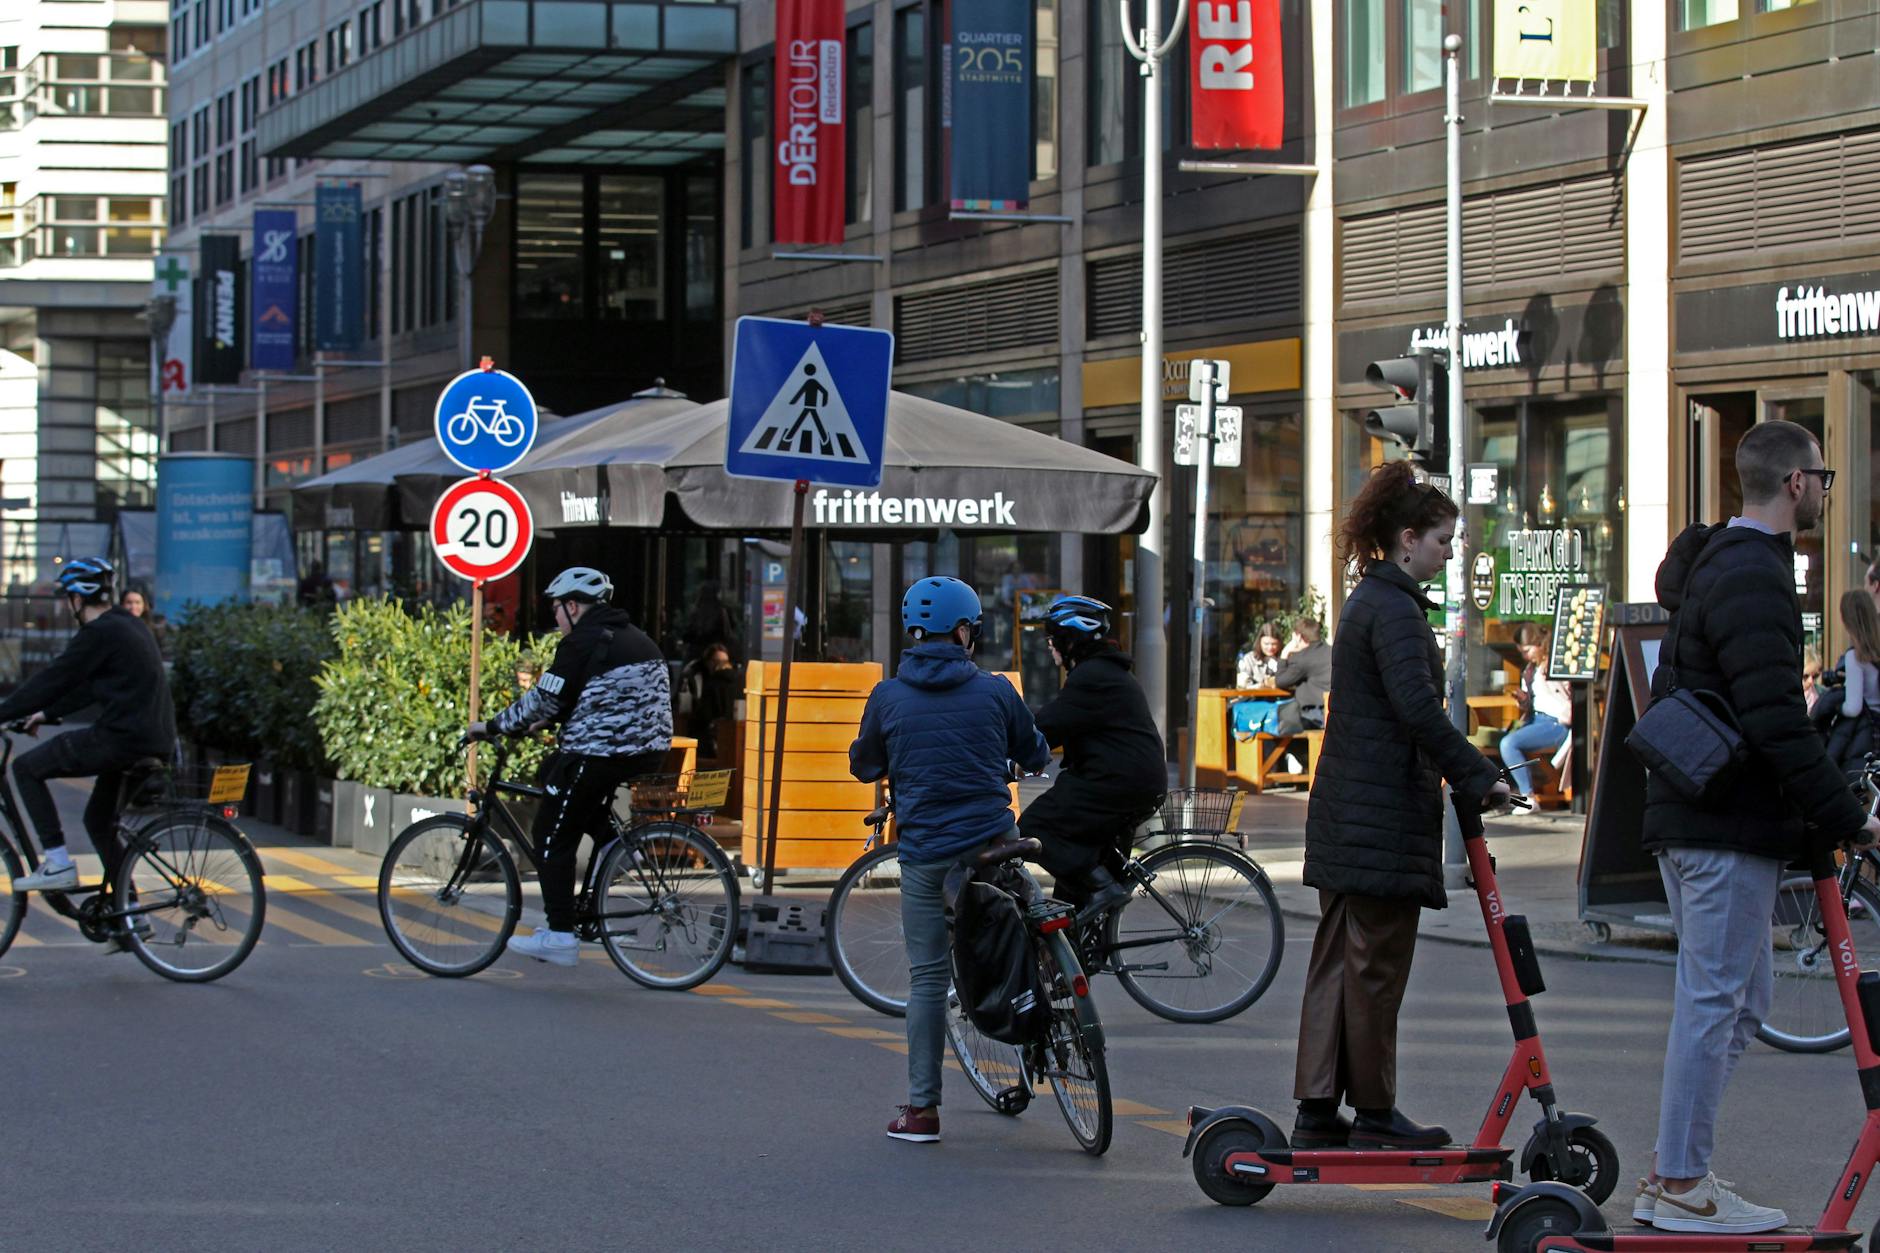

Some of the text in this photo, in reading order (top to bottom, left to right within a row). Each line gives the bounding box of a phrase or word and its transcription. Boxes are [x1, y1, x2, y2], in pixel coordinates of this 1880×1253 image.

[958, 32, 1022, 44] QUARTIER
[959, 47, 1023, 71] 205
[824, 45, 838, 119] Reisebüro
[959, 73, 1022, 83] STADTMITTE
[789, 39, 818, 186] DERTOUR
[813, 489, 1016, 525] frittenwerk
[459, 508, 508, 548] 20
[1508, 529, 1553, 572] THANK
[768, 563, 782, 583] P
[1629, 605, 1653, 623] 30
[1486, 890, 1506, 924] voi.
[1838, 938, 1858, 977] voi.
